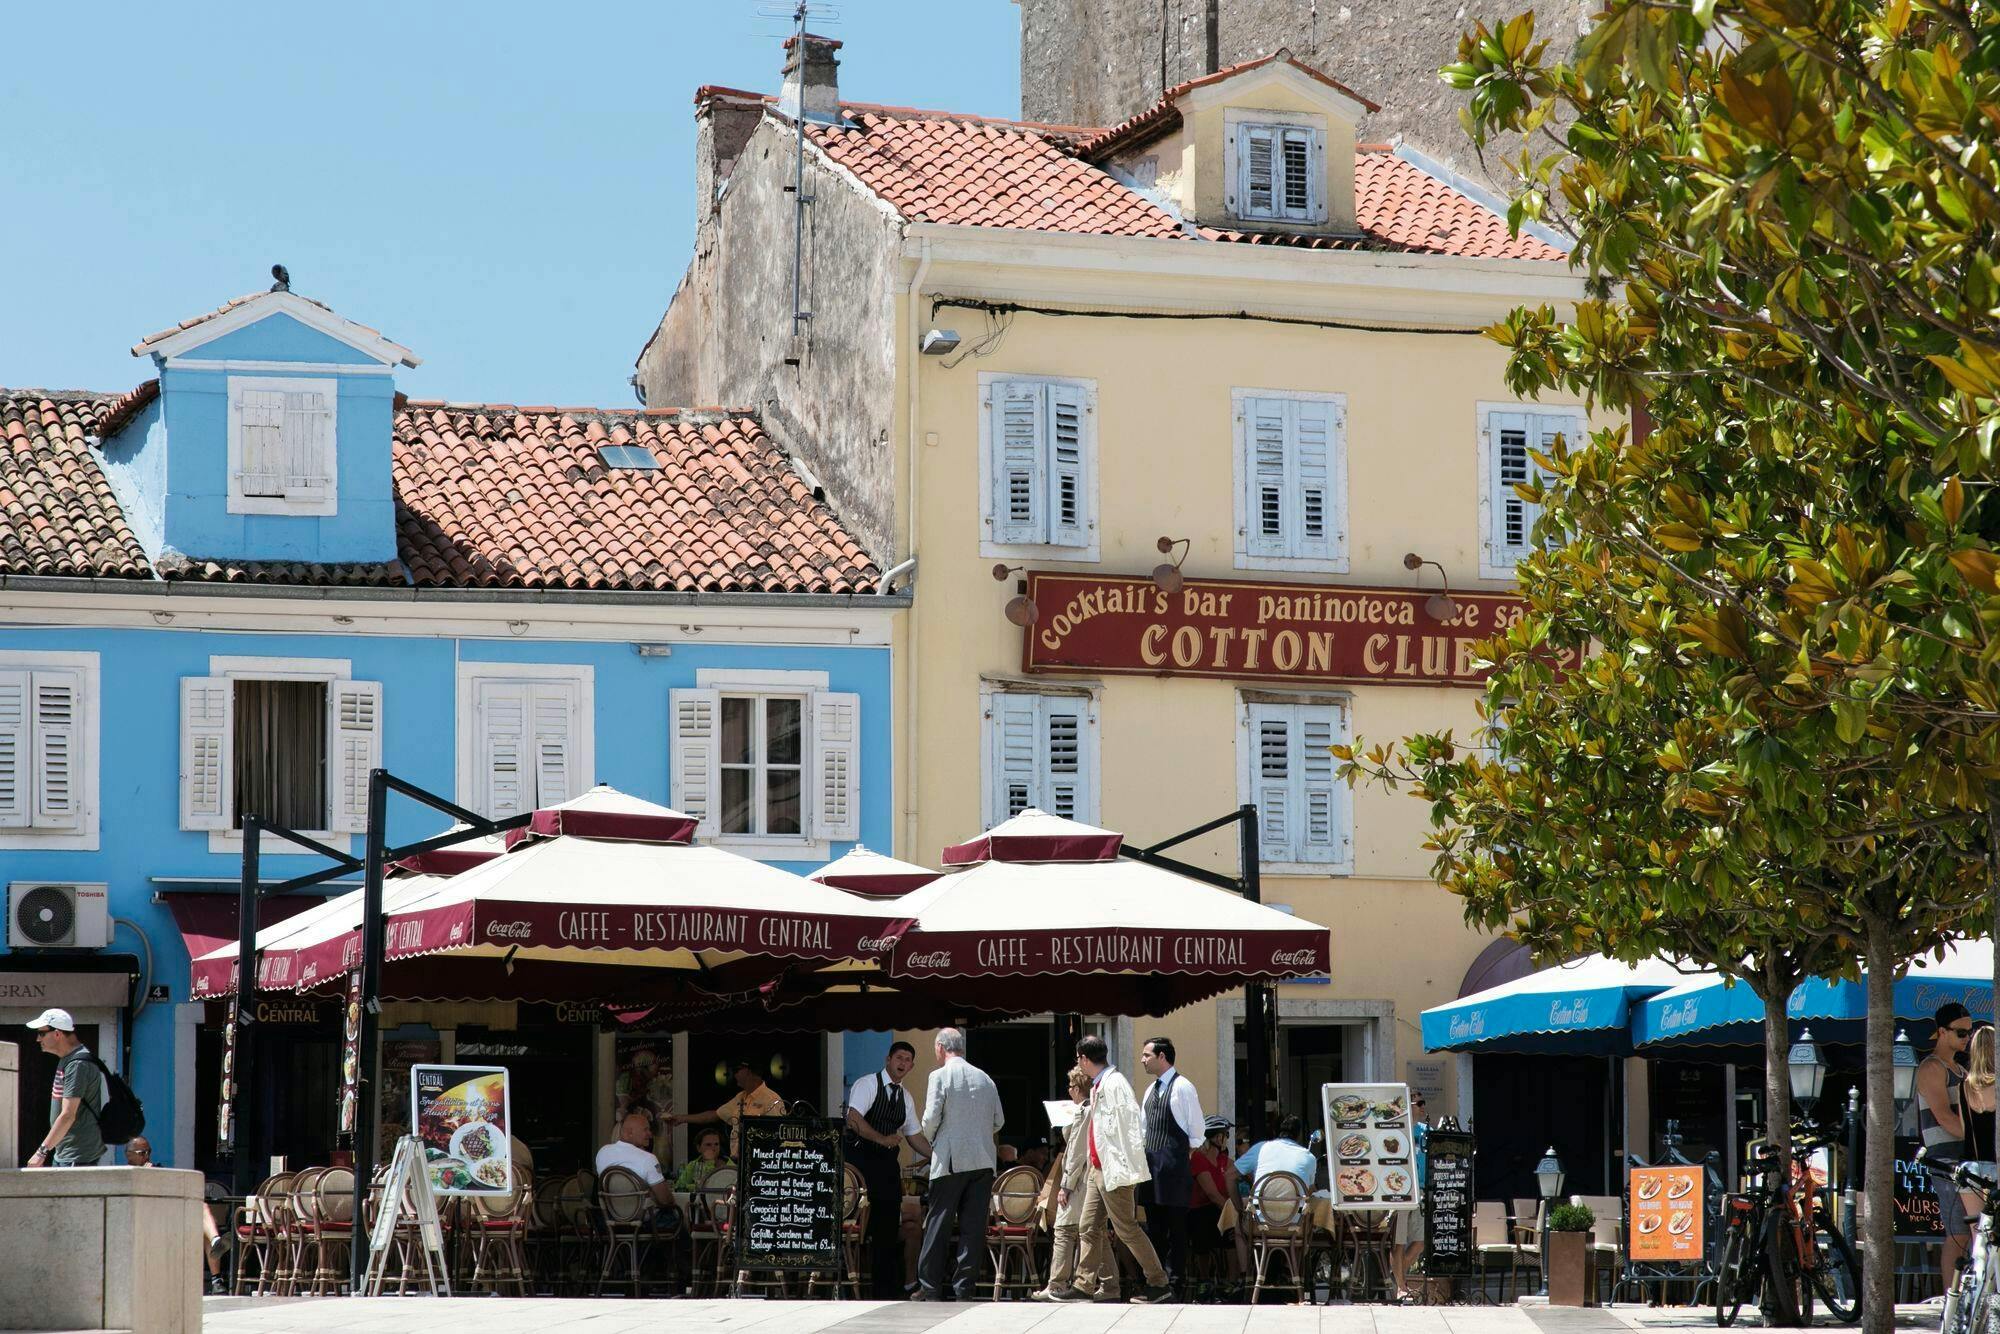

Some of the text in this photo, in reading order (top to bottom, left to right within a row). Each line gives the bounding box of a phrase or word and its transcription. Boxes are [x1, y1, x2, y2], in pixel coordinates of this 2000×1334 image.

[1184, 587, 1233, 617] bar
[1258, 594, 1415, 626] paninoteca
[1441, 602, 1479, 627] ce
[1140, 624, 1479, 677] COTTON CLUB
[486, 919, 532, 938] Coca-Cola
[559, 911, 610, 941] CAFFE
[634, 913, 748, 943] RESTAURANT
[759, 917, 832, 949] CENTRAL
[907, 951, 951, 968] Coca-Cola
[977, 938, 1028, 967] CAFFE
[1052, 935, 1164, 965] RESTAURANT
[1174, 936, 1247, 965] CENTRAL
[1271, 949, 1318, 966] Coca-Cola
[153, 986, 161, 997] 4
[257, 1002, 319, 1023] CENTRAL
[556, 1004, 600, 1022] CENTR
[419, 1072, 444, 1086] CENTRAL
[778, 1124, 808, 1141] CENTRAL
[761, 1160, 780, 1170] Salat
[751, 1175, 779, 1187] Calamari
[760, 1187, 777, 1196] Salat
[760, 1214, 777, 1223] Salat
[793, 1204, 815, 1217] Beilage
